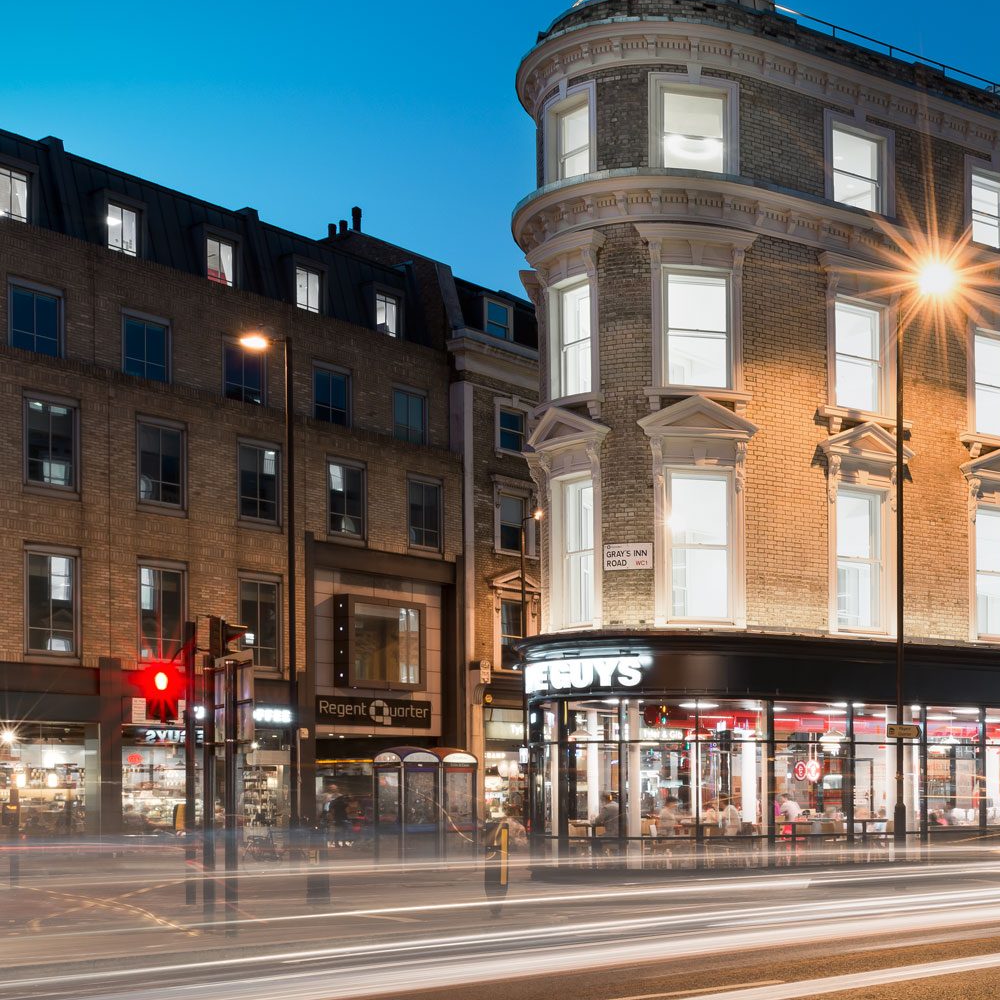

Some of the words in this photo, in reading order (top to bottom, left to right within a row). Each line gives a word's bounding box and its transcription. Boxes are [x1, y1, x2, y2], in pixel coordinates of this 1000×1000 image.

[606, 550, 631, 558] GRAY'S
[549, 656, 642, 690] GUYS
[319, 700, 367, 718] Regent
[369, 699, 430, 726] Quarter
